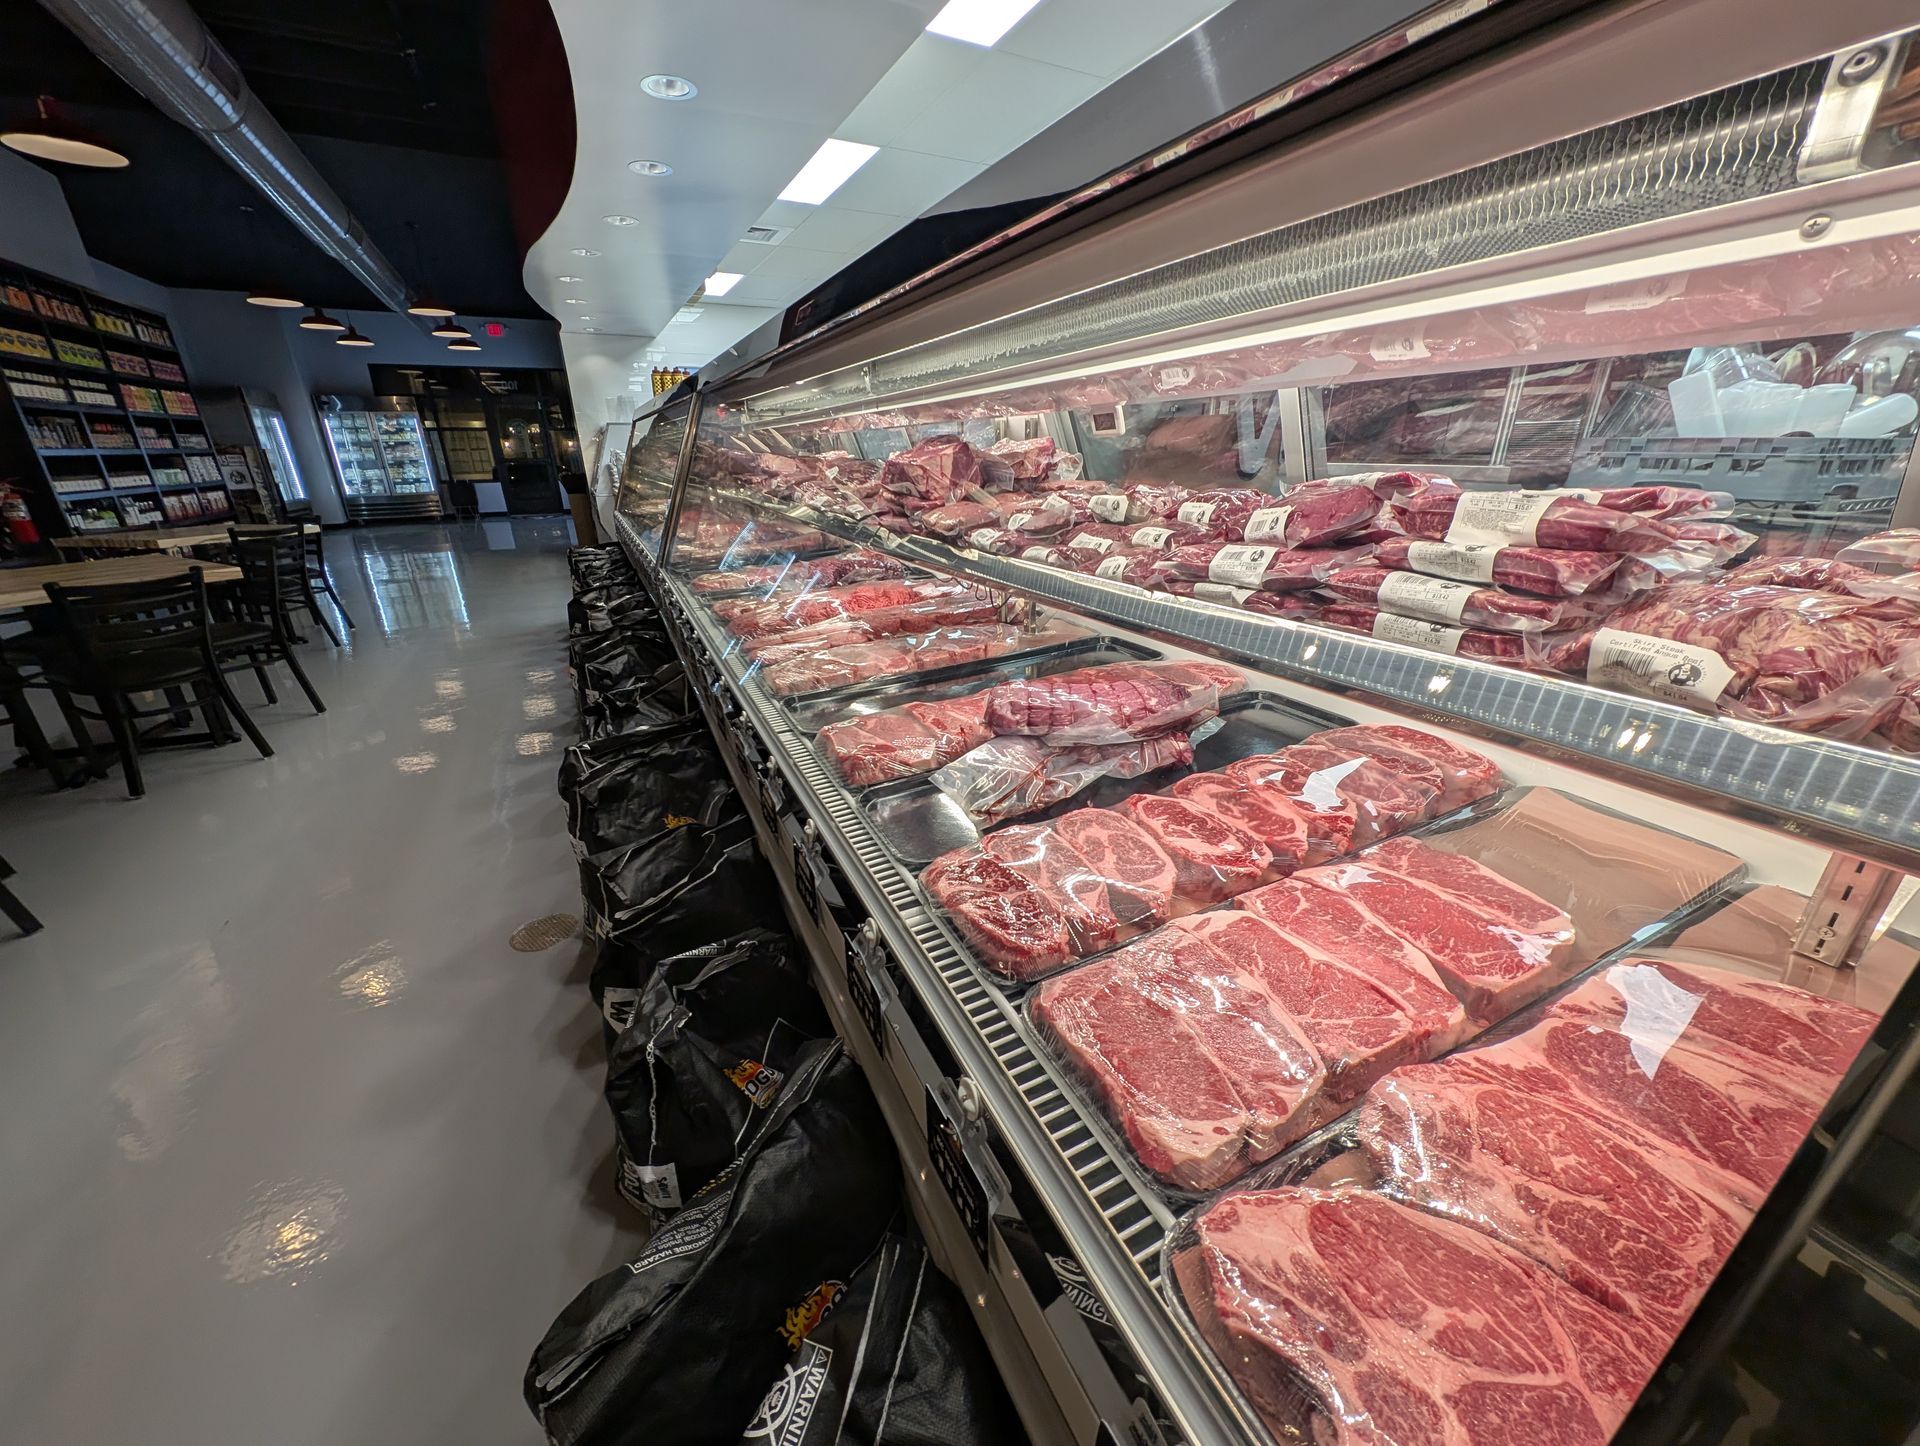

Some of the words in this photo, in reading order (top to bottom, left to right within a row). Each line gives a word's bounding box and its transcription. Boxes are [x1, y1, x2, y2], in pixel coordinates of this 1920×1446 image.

[1609, 639, 1651, 653] Certified
[1654, 649, 1679, 659] Angus
[1633, 638, 1656, 648] Skirt
[1661, 644, 1686, 655] Steak
[684, 1225, 716, 1242] charcoal
[635, 1250, 673, 1268] HAZARD
[784, 1366, 825, 1446] WARNI
